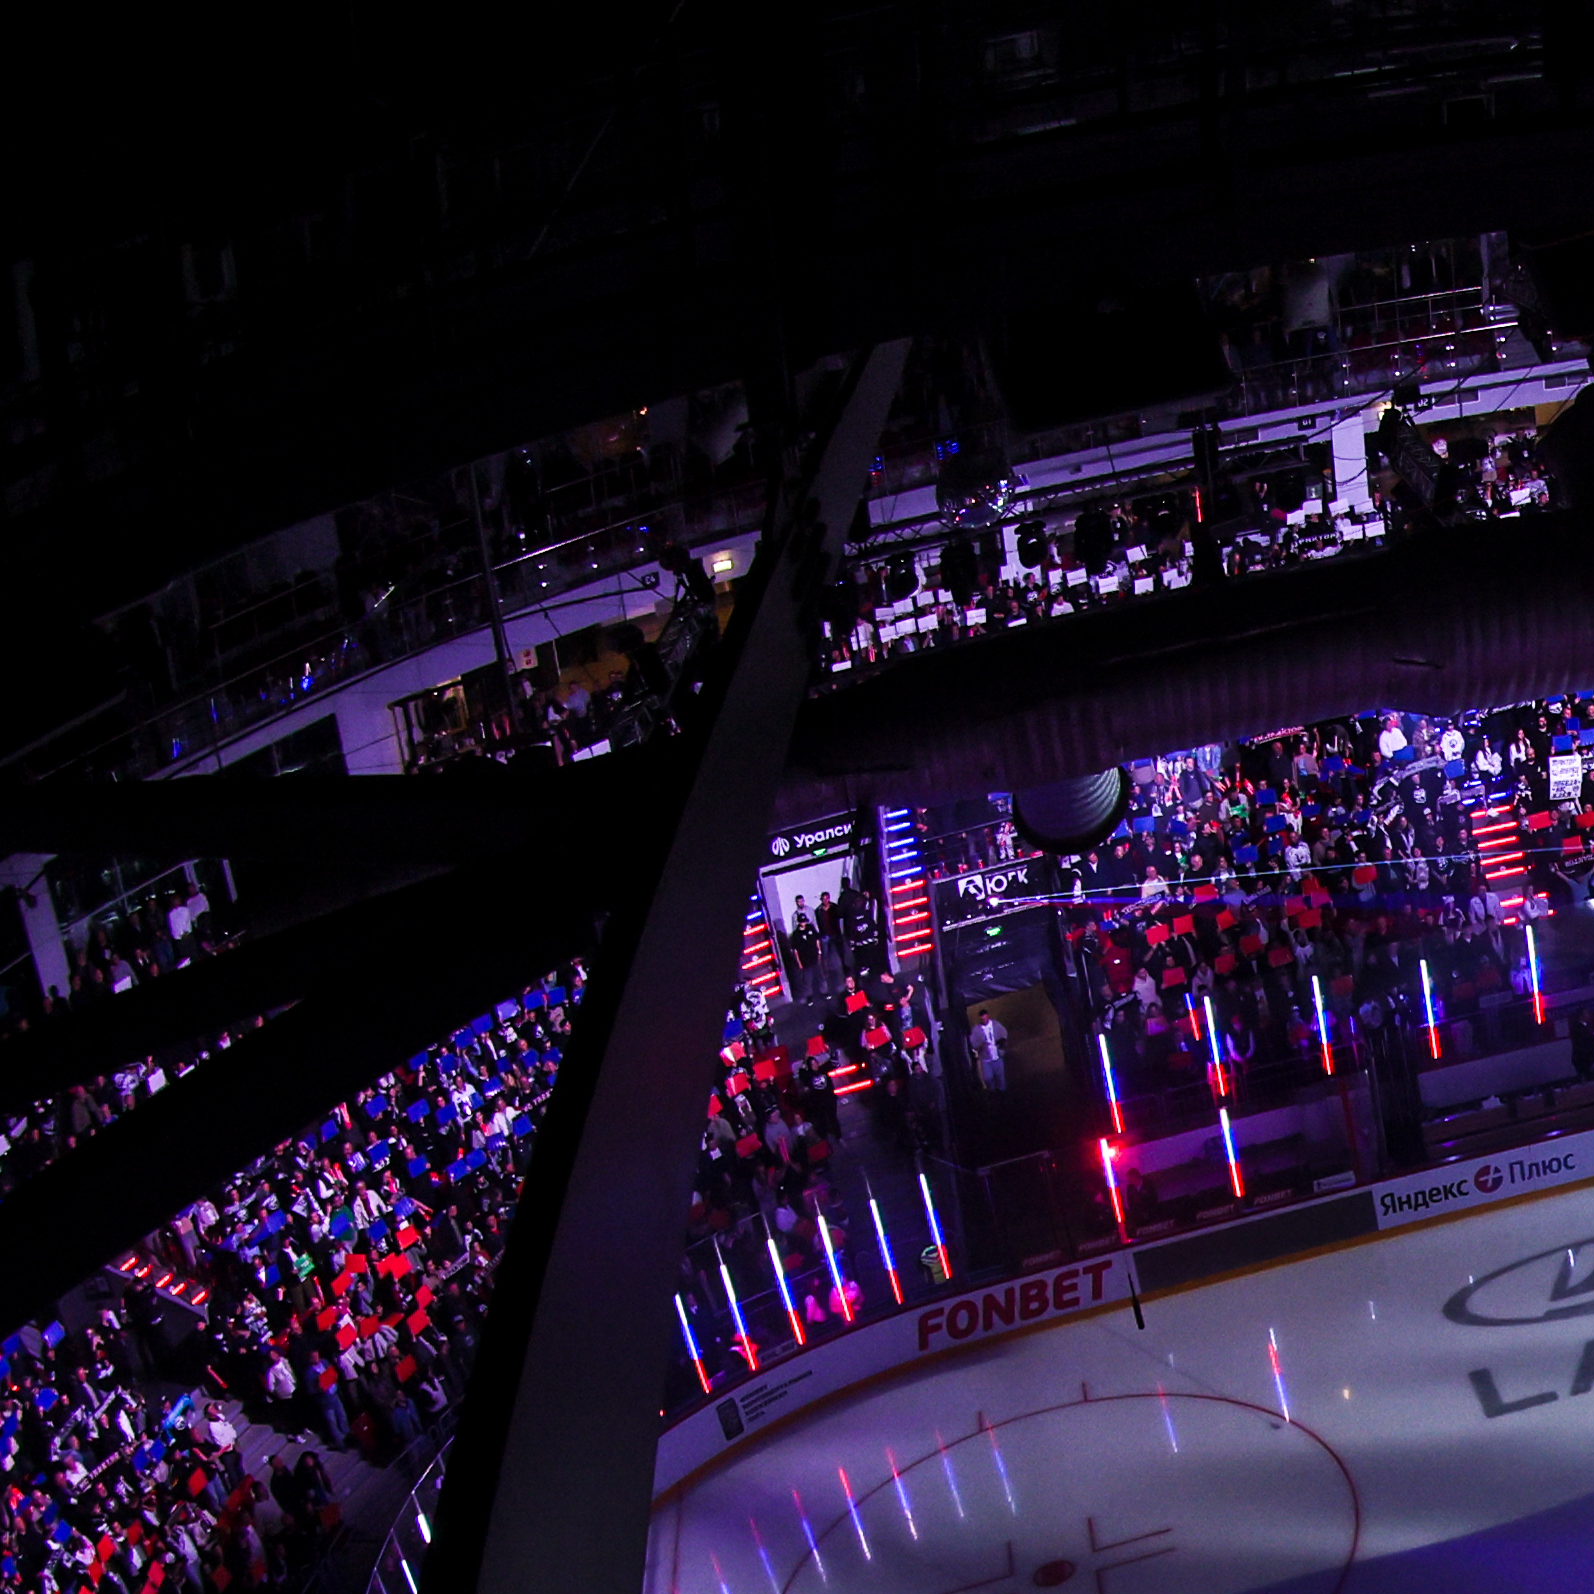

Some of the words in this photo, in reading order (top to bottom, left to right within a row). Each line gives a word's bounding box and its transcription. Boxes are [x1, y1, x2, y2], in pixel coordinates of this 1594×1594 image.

[793, 822, 856, 850] Уралси
[1380, 1176, 1470, 1218] Яндекс
[1508, 1150, 1576, 1185] Плюс
[918, 1260, 1113, 1352] FONBET
